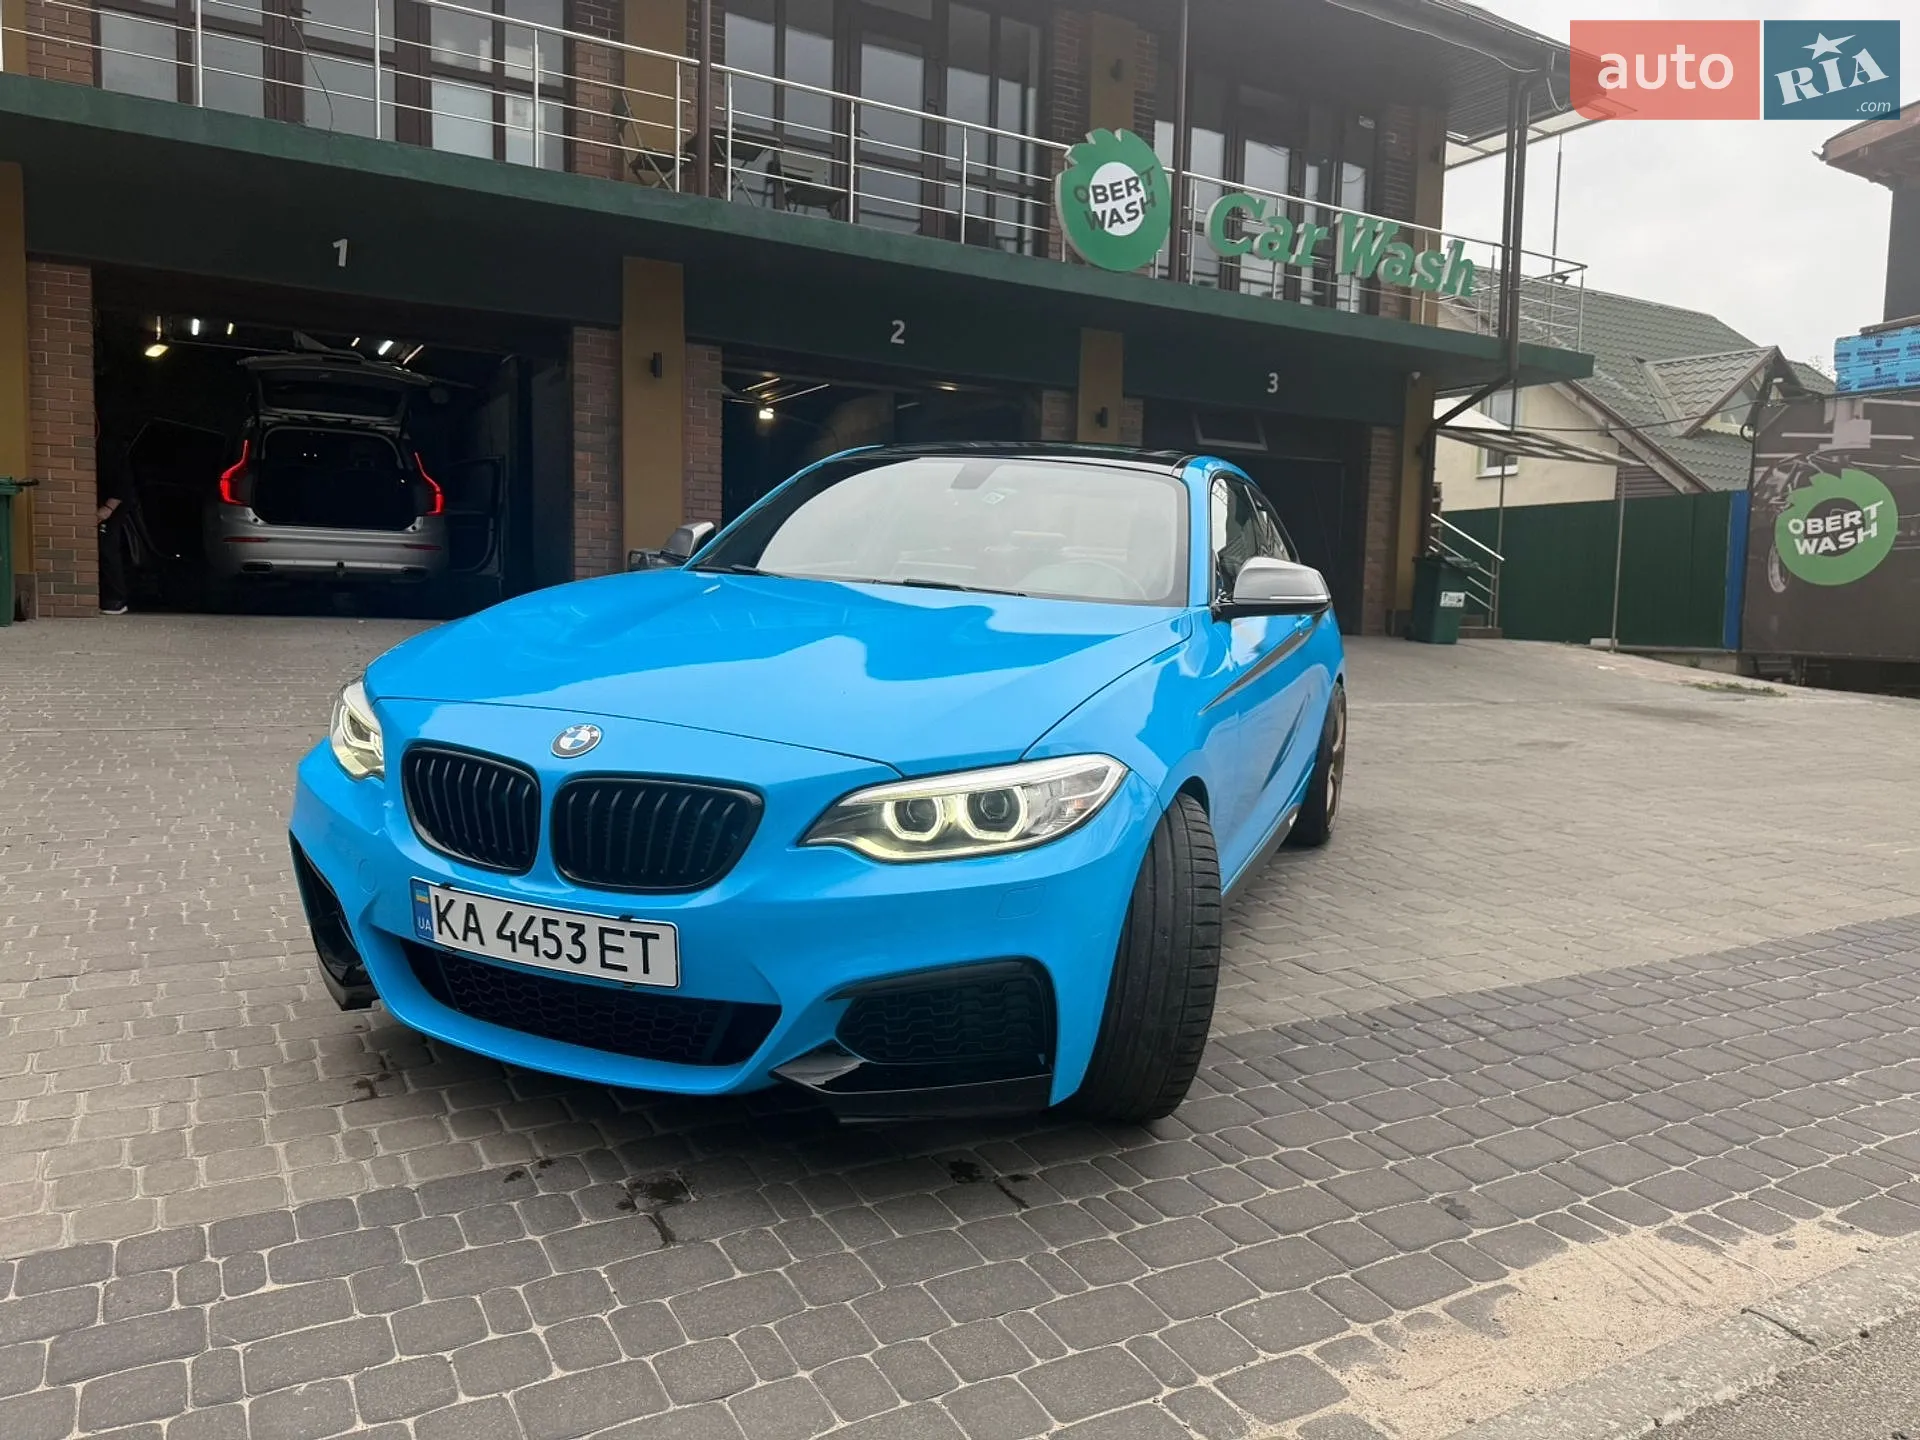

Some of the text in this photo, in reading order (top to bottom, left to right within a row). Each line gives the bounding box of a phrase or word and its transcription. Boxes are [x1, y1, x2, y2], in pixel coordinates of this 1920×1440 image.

[1073, 165, 1155, 205] OBERT
[1083, 190, 1157, 231] WASH
[332, 238, 348, 267] 1
[1205, 191, 1478, 298] Car Wash
[890, 319, 905, 345] 2
[1267, 372, 1279, 393] 3
[1788, 500, 1884, 535] OBERT
[1794, 521, 1879, 556] WASH
[417, 915, 432, 931] UA
[434, 894, 660, 975] KA 4453 ET
